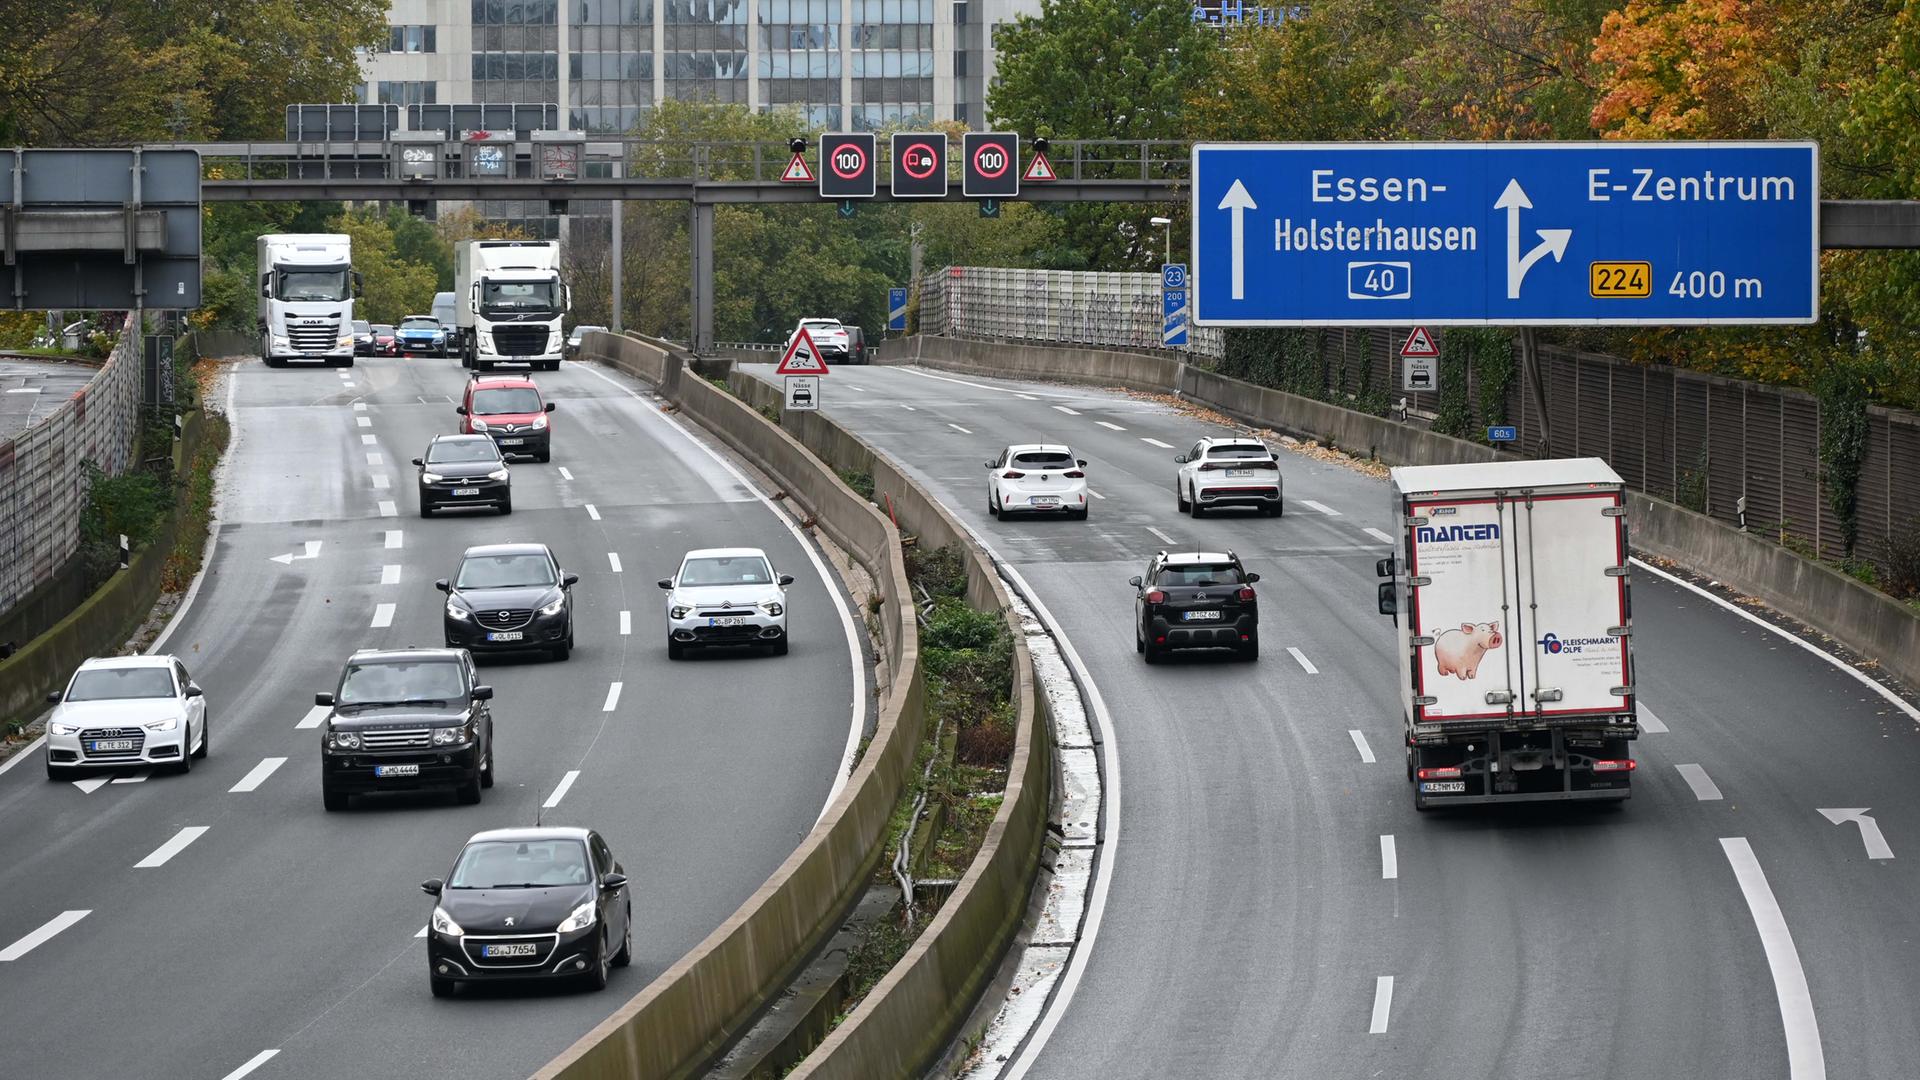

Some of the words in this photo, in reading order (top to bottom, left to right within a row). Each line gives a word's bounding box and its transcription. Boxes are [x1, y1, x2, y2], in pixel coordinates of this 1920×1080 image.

[837, 153, 859, 169] 100
[979, 153, 1002, 169] 100
[1312, 169, 1447, 202] Essen-
[1588, 168, 1795, 201] E-Zentrum
[1274, 218, 1477, 251] Holsterhausen
[1167, 271, 1181, 282] 23
[1364, 269, 1395, 292] 40
[1598, 268, 1643, 290] 224
[1668, 270, 1726, 299] 400
[1734, 277, 1762, 298] m
[1167, 292, 1182, 301] 200
[1416, 524, 1500, 543] MANTEN
[1562, 637, 1619, 646] FLEISCHMARKT
[1562, 646, 1582, 654] OLPE
[118, 741, 130, 749] 312
[1452, 782, 1464, 790] 492
[512, 945, 535, 954] 7654
